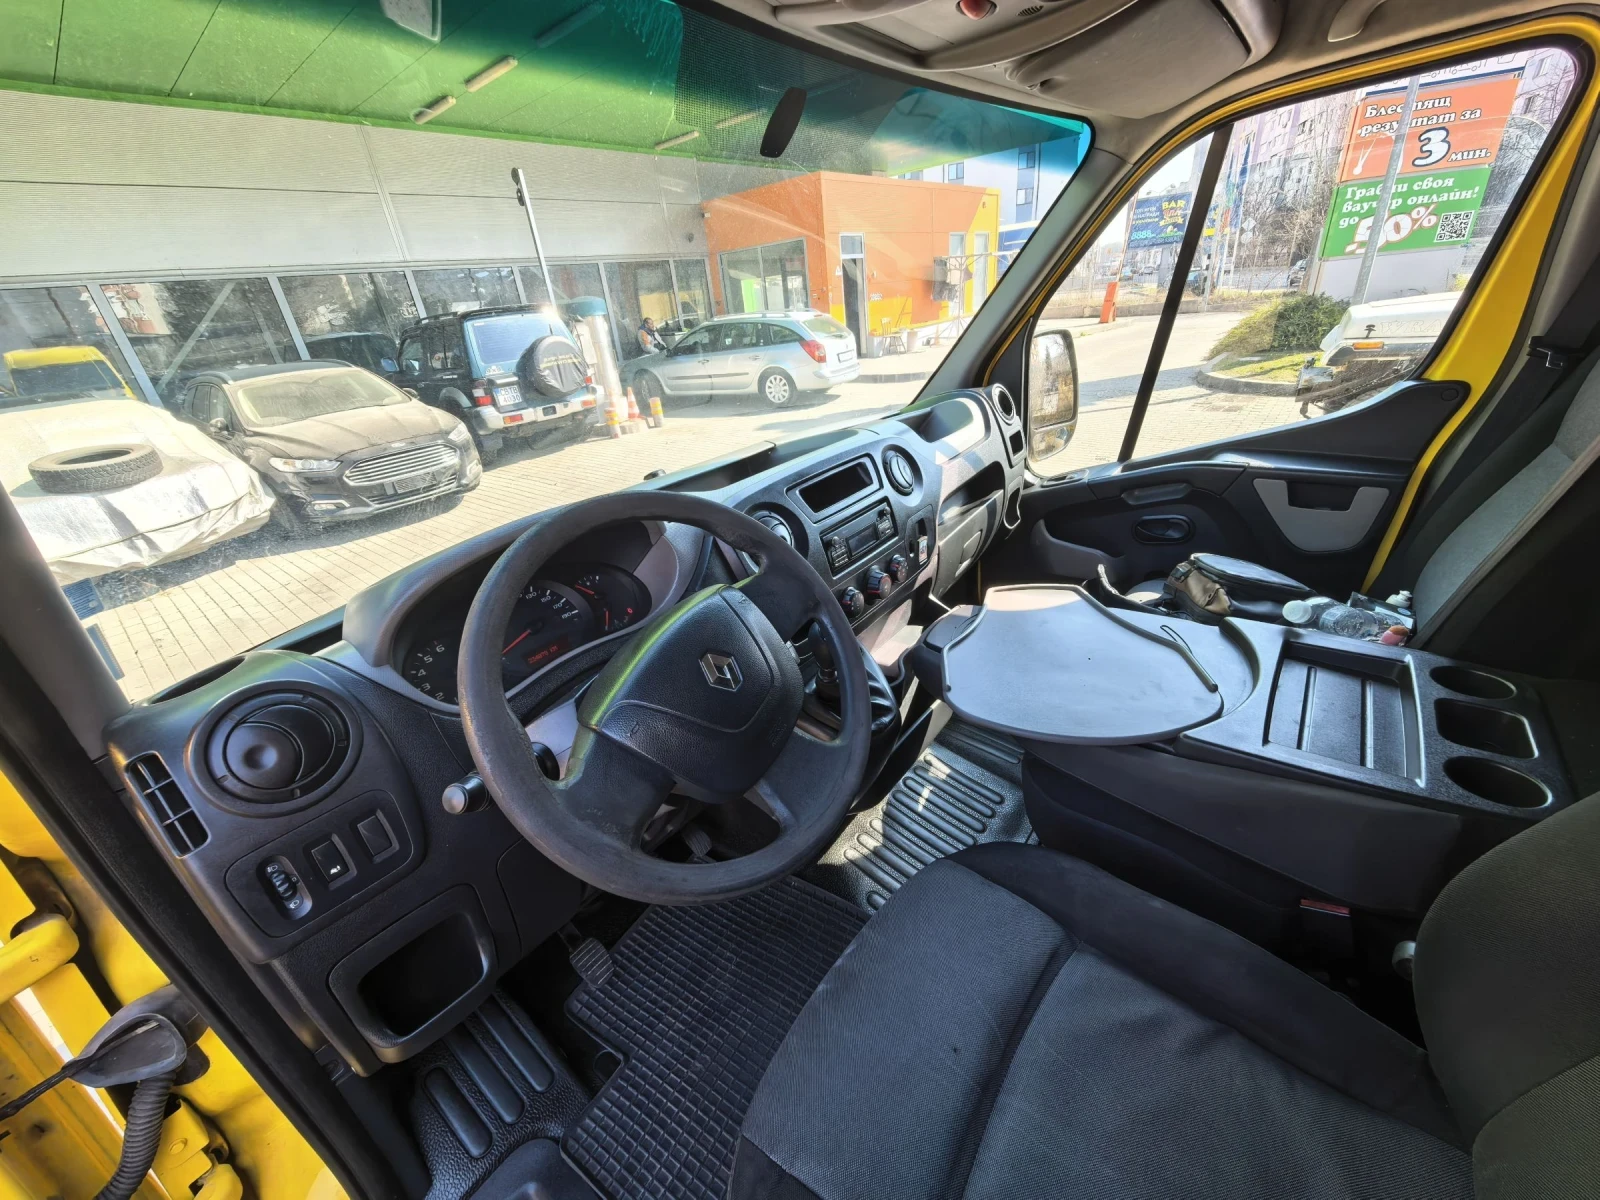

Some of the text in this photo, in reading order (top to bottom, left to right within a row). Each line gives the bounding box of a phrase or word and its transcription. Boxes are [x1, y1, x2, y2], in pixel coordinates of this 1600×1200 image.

[1360, 108, 1481, 137] резутат за
[1412, 126, 1451, 167] 3
[1447, 148, 1491, 162] мин.
[1413, 177, 1455, 191] своя
[1407, 186, 1479, 206] онлайн!
[1162, 200, 1185, 210] BAR
[1338, 216, 1359, 228] до
[525, 591, 537, 600] 130
[541, 595, 552, 603] 150
[561, 611, 572, 619] 190
[436, 644, 445, 653] 6
[424, 655, 433, 663] 5
[422, 683, 431, 691] 3
[435, 692, 445, 700] 2
